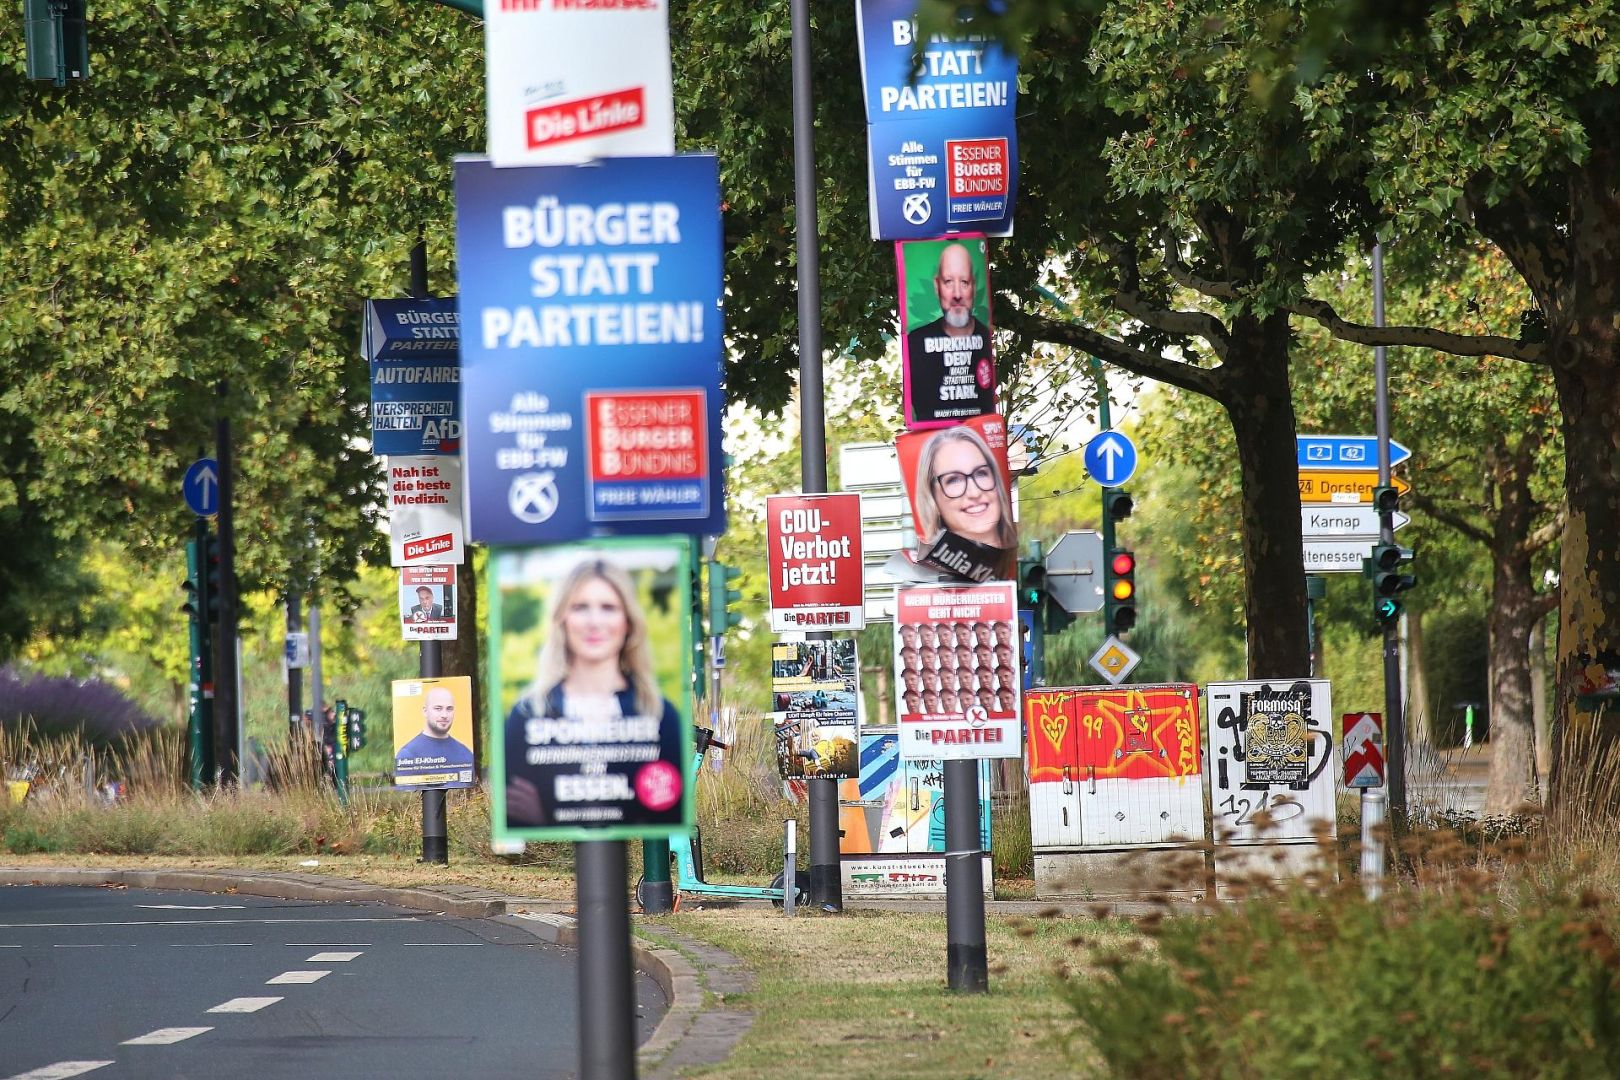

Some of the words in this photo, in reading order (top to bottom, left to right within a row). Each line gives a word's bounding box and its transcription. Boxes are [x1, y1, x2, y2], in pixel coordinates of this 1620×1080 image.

[880, 82, 1008, 112] PARTEIEN!
[533, 111, 577, 142] Die
[577, 99, 641, 133] Linke
[902, 141, 924, 154] Alle
[953, 146, 1002, 161] ESSENER
[888, 155, 938, 166] Stimmen
[905, 166, 922, 177] für
[954, 161, 1003, 177] BÜRGER
[894, 177, 936, 190] EBB-FW
[955, 177, 1003, 193] BÜNDNIS
[952, 203, 973, 213] FREIE
[974, 201, 1002, 212] WÄHLER
[502, 194, 682, 249] BÜRGER
[529, 252, 660, 298] STATT
[481, 300, 705, 350] PARTEIEN!
[411, 327, 461, 339] STATT
[924, 335, 984, 353] BURKHARD
[939, 385, 979, 401] STARK.
[375, 403, 452, 416] VERSPRECHEN
[375, 416, 421, 430] HALTEN.
[422, 419, 463, 439] AfD
[1317, 448, 1323, 457] 2
[1346, 448, 1358, 458] 42
[392, 467, 420, 478] Nah
[422, 466, 439, 477] ist
[393, 480, 413, 491] die
[417, 480, 451, 490] beste
[1321, 481, 1373, 493] Dorsten
[394, 493, 449, 505] Medizin.
[780, 508, 830, 534] CDU-
[1311, 515, 1360, 530] Karnap
[408, 545, 425, 557] Die
[425, 539, 451, 552] Linke
[780, 535, 851, 560] Verbot
[932, 543, 972, 575] Julia
[1303, 550, 1363, 562] ltenessen
[781, 560, 836, 592] jetzt!
[784, 612, 796, 622] Die
[796, 611, 850, 626] PARTEI
[417, 626, 449, 634] PARTEI
[1251, 699, 1301, 717] FORMOSA
[915, 728, 931, 741] Die
[931, 727, 1004, 746] PARTEI
[851, 863, 947, 871] www.kunst-stueck-ess
